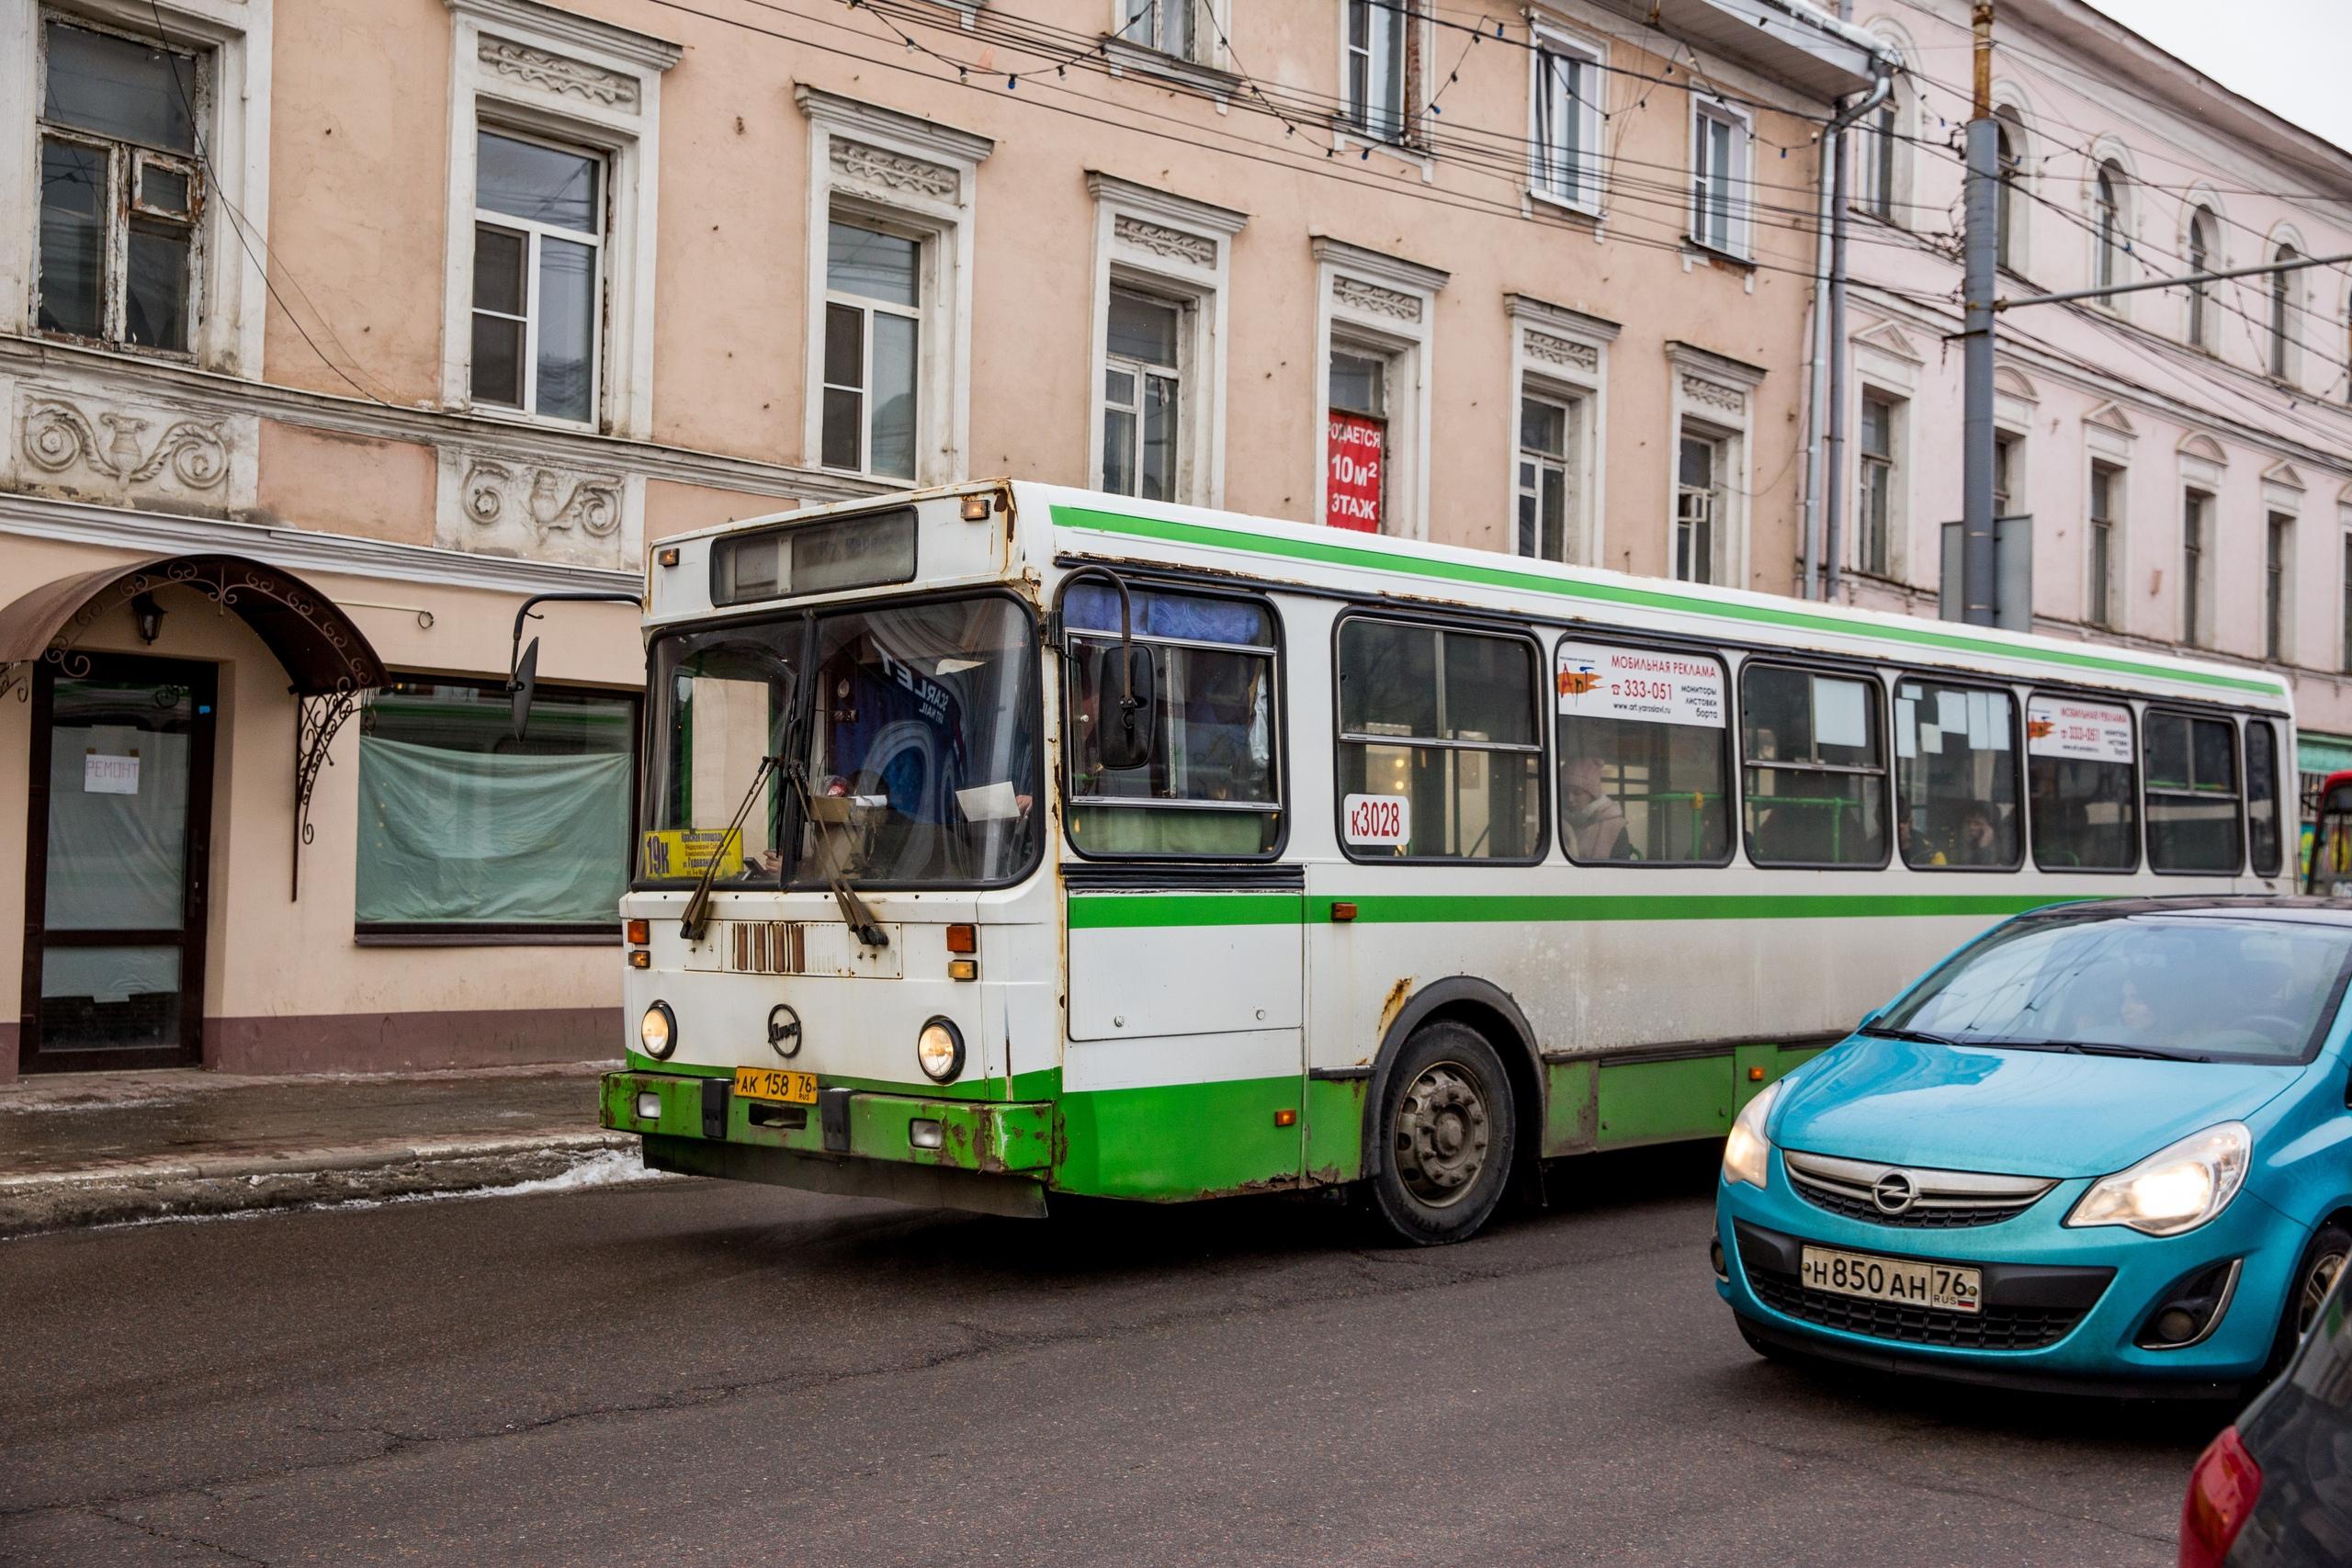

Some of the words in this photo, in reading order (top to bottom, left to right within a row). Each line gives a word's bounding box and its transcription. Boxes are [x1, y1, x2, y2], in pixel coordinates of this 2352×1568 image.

[1331, 492, 1376, 520] ЭТАЖ
[1611, 655, 1670, 673] МОБИЛЬНАЯ
[1673, 661, 1716, 678] РЕКЛАМА
[1624, 679, 1672, 700] 333-051
[1680, 684, 1717, 696] мониторы
[1696, 707, 1718, 720] борта
[86, 760, 140, 780] РЕМОНТ
[764, 1073, 789, 1096] 158
[798, 1076, 812, 1093] 76
[1936, 1270, 1966, 1296] 76
[1933, 1294, 1957, 1305] RUS
